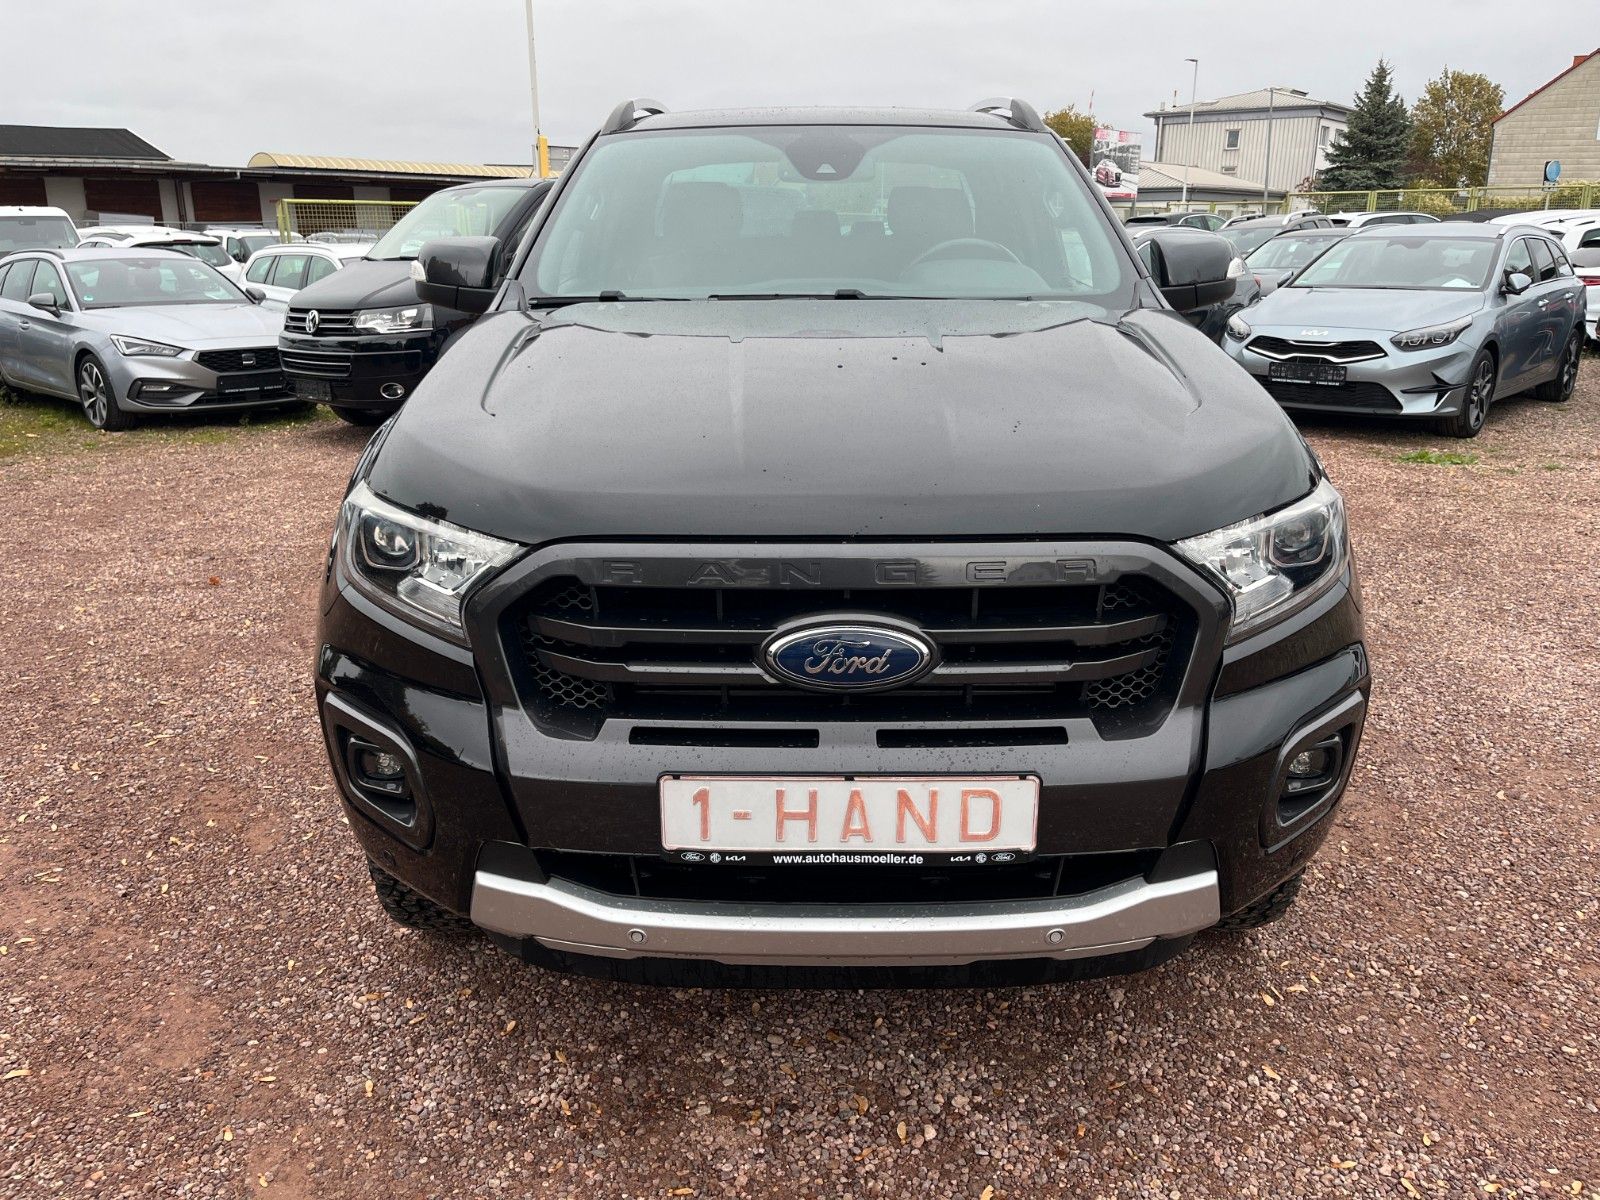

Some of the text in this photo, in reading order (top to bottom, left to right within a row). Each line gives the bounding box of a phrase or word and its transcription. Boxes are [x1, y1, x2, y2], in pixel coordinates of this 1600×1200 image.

[602, 557, 1098, 586] RANGER
[803, 639, 892, 676] Ford
[710, 852, 721, 863] MG
[773, 853, 924, 865] www.autohausmoeller.de
[975, 853, 987, 863] MG
